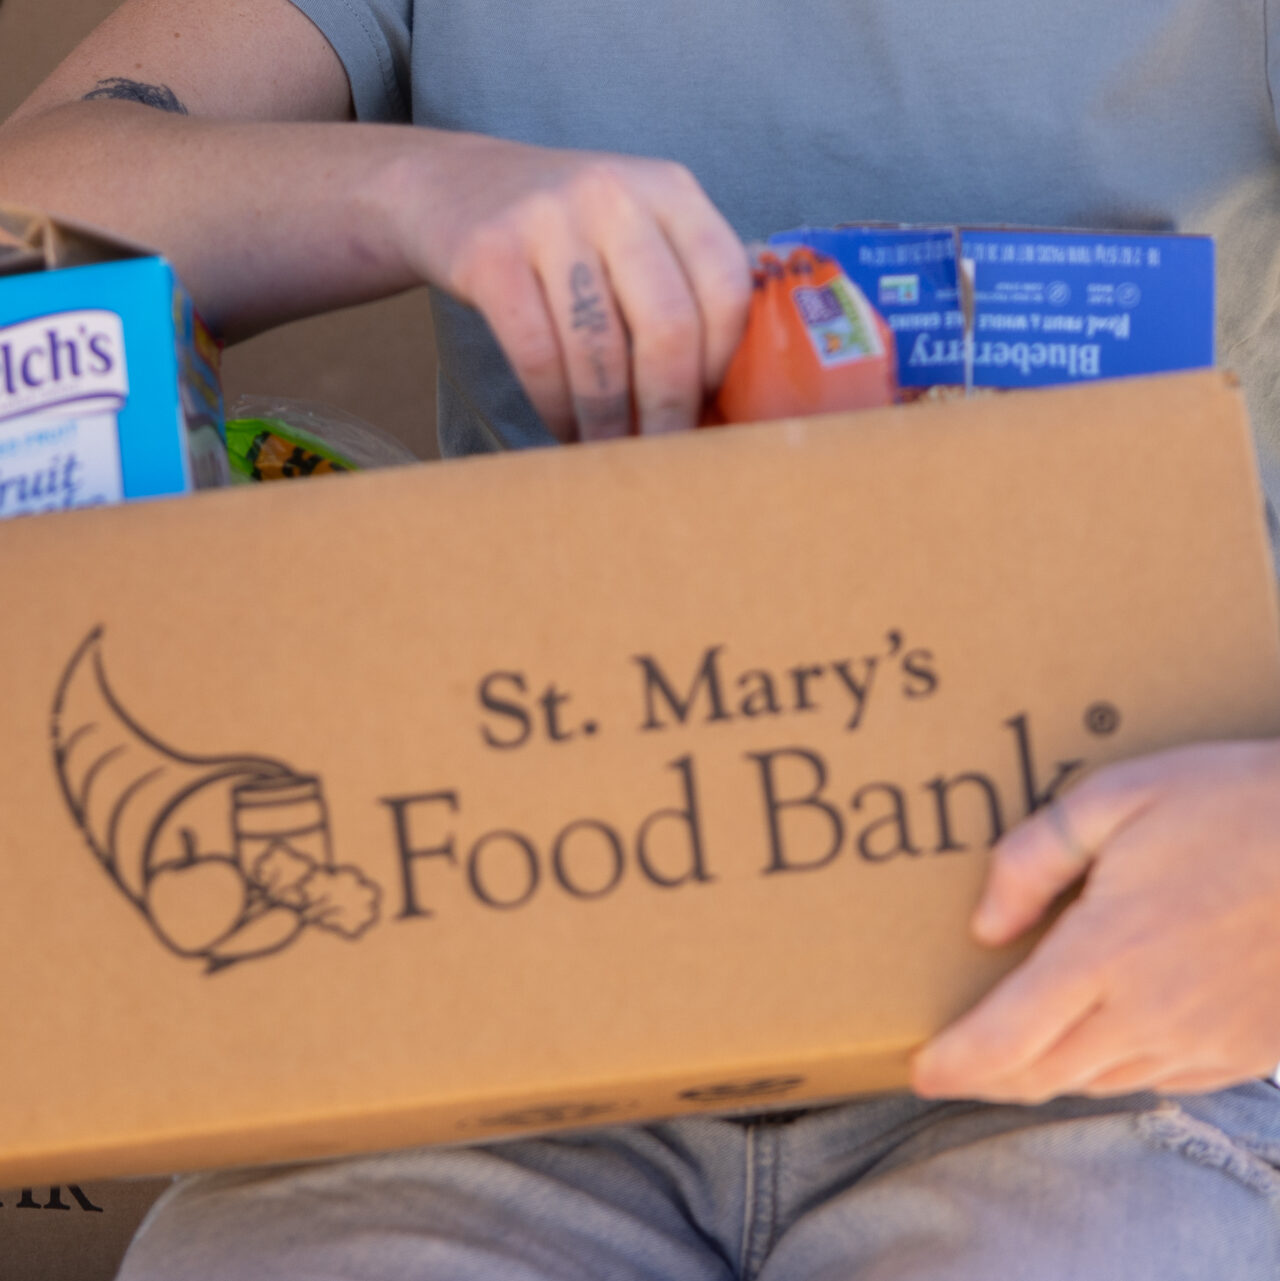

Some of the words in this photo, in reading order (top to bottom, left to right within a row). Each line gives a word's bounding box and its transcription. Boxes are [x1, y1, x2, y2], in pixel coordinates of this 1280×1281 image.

[476, 670, 600, 751] St.
[634, 630, 942, 732] Mary's
[378, 754, 716, 923] Food
